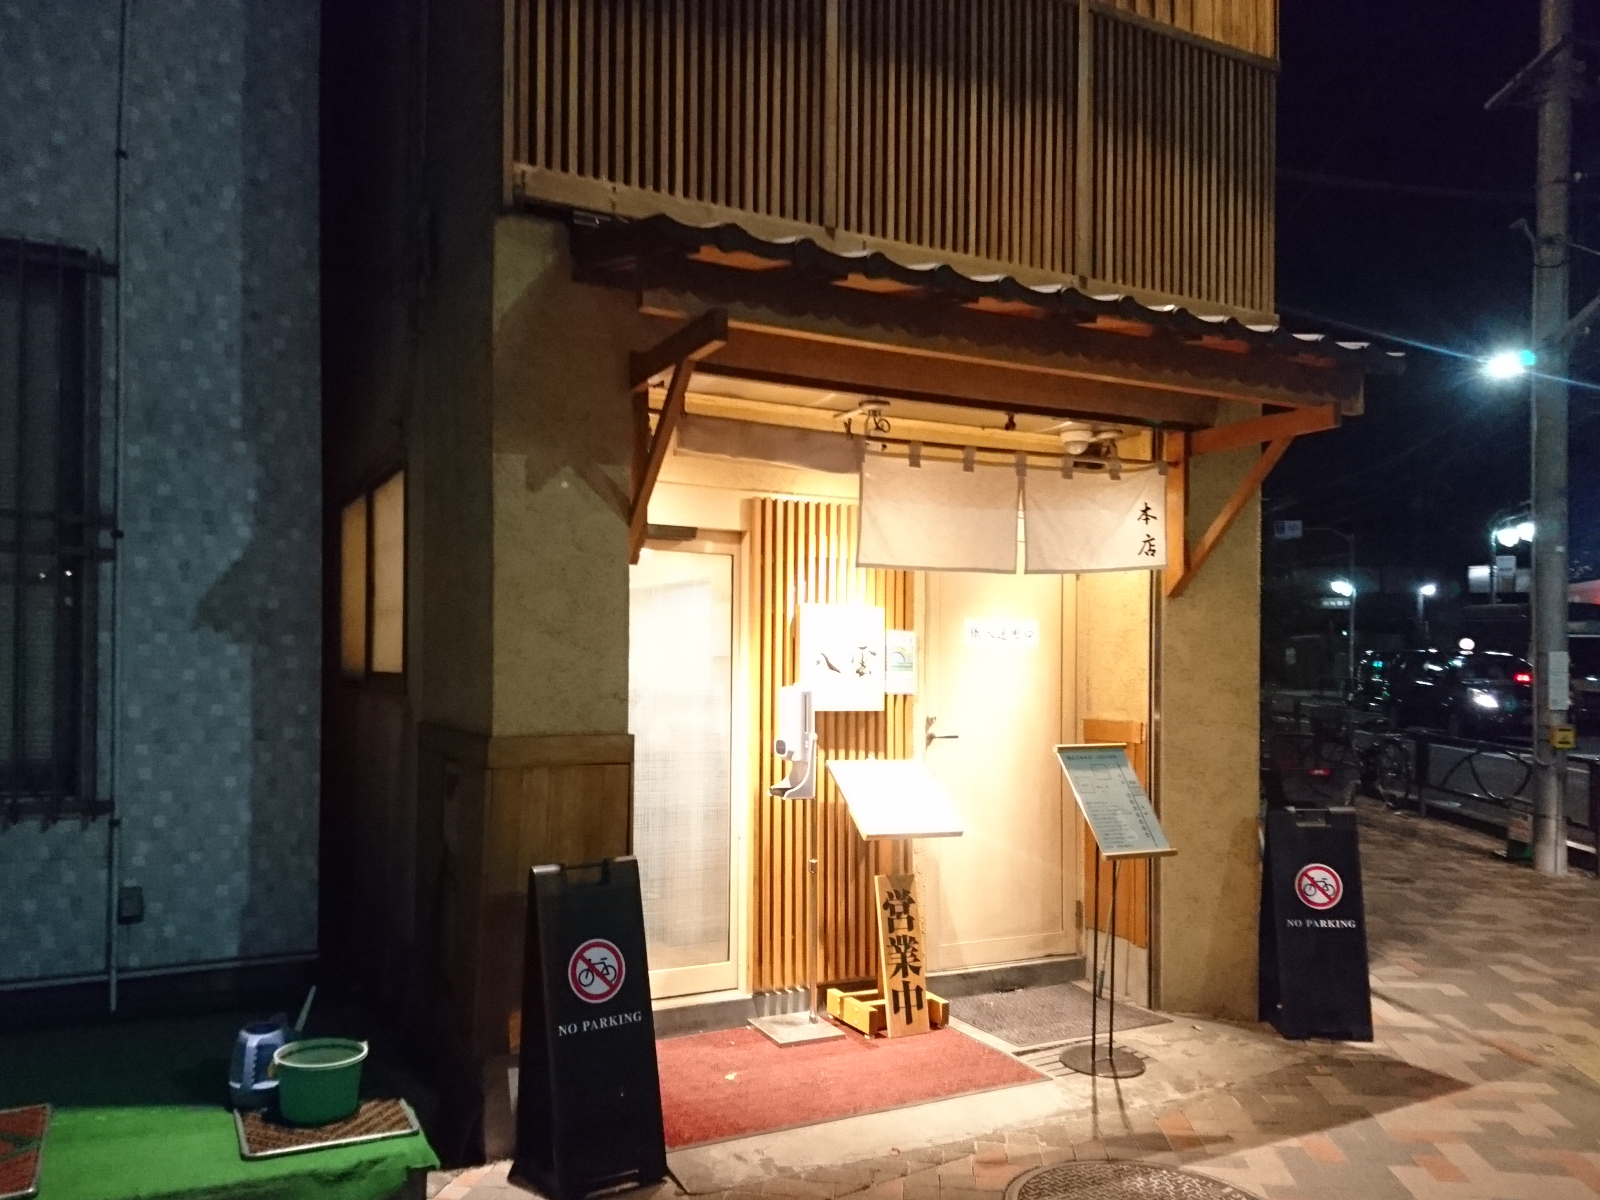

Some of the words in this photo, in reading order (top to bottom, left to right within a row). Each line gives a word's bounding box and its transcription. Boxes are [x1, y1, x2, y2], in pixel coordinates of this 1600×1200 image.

[1137, 502, 1157, 557] 本店
[1286, 918, 1303, 928] NO
[1306, 919, 1356, 928] PARKING
[882, 888, 924, 1026] 営業中
[558, 1022, 578, 1037] NO
[582, 1010, 642, 1032] PARKING
